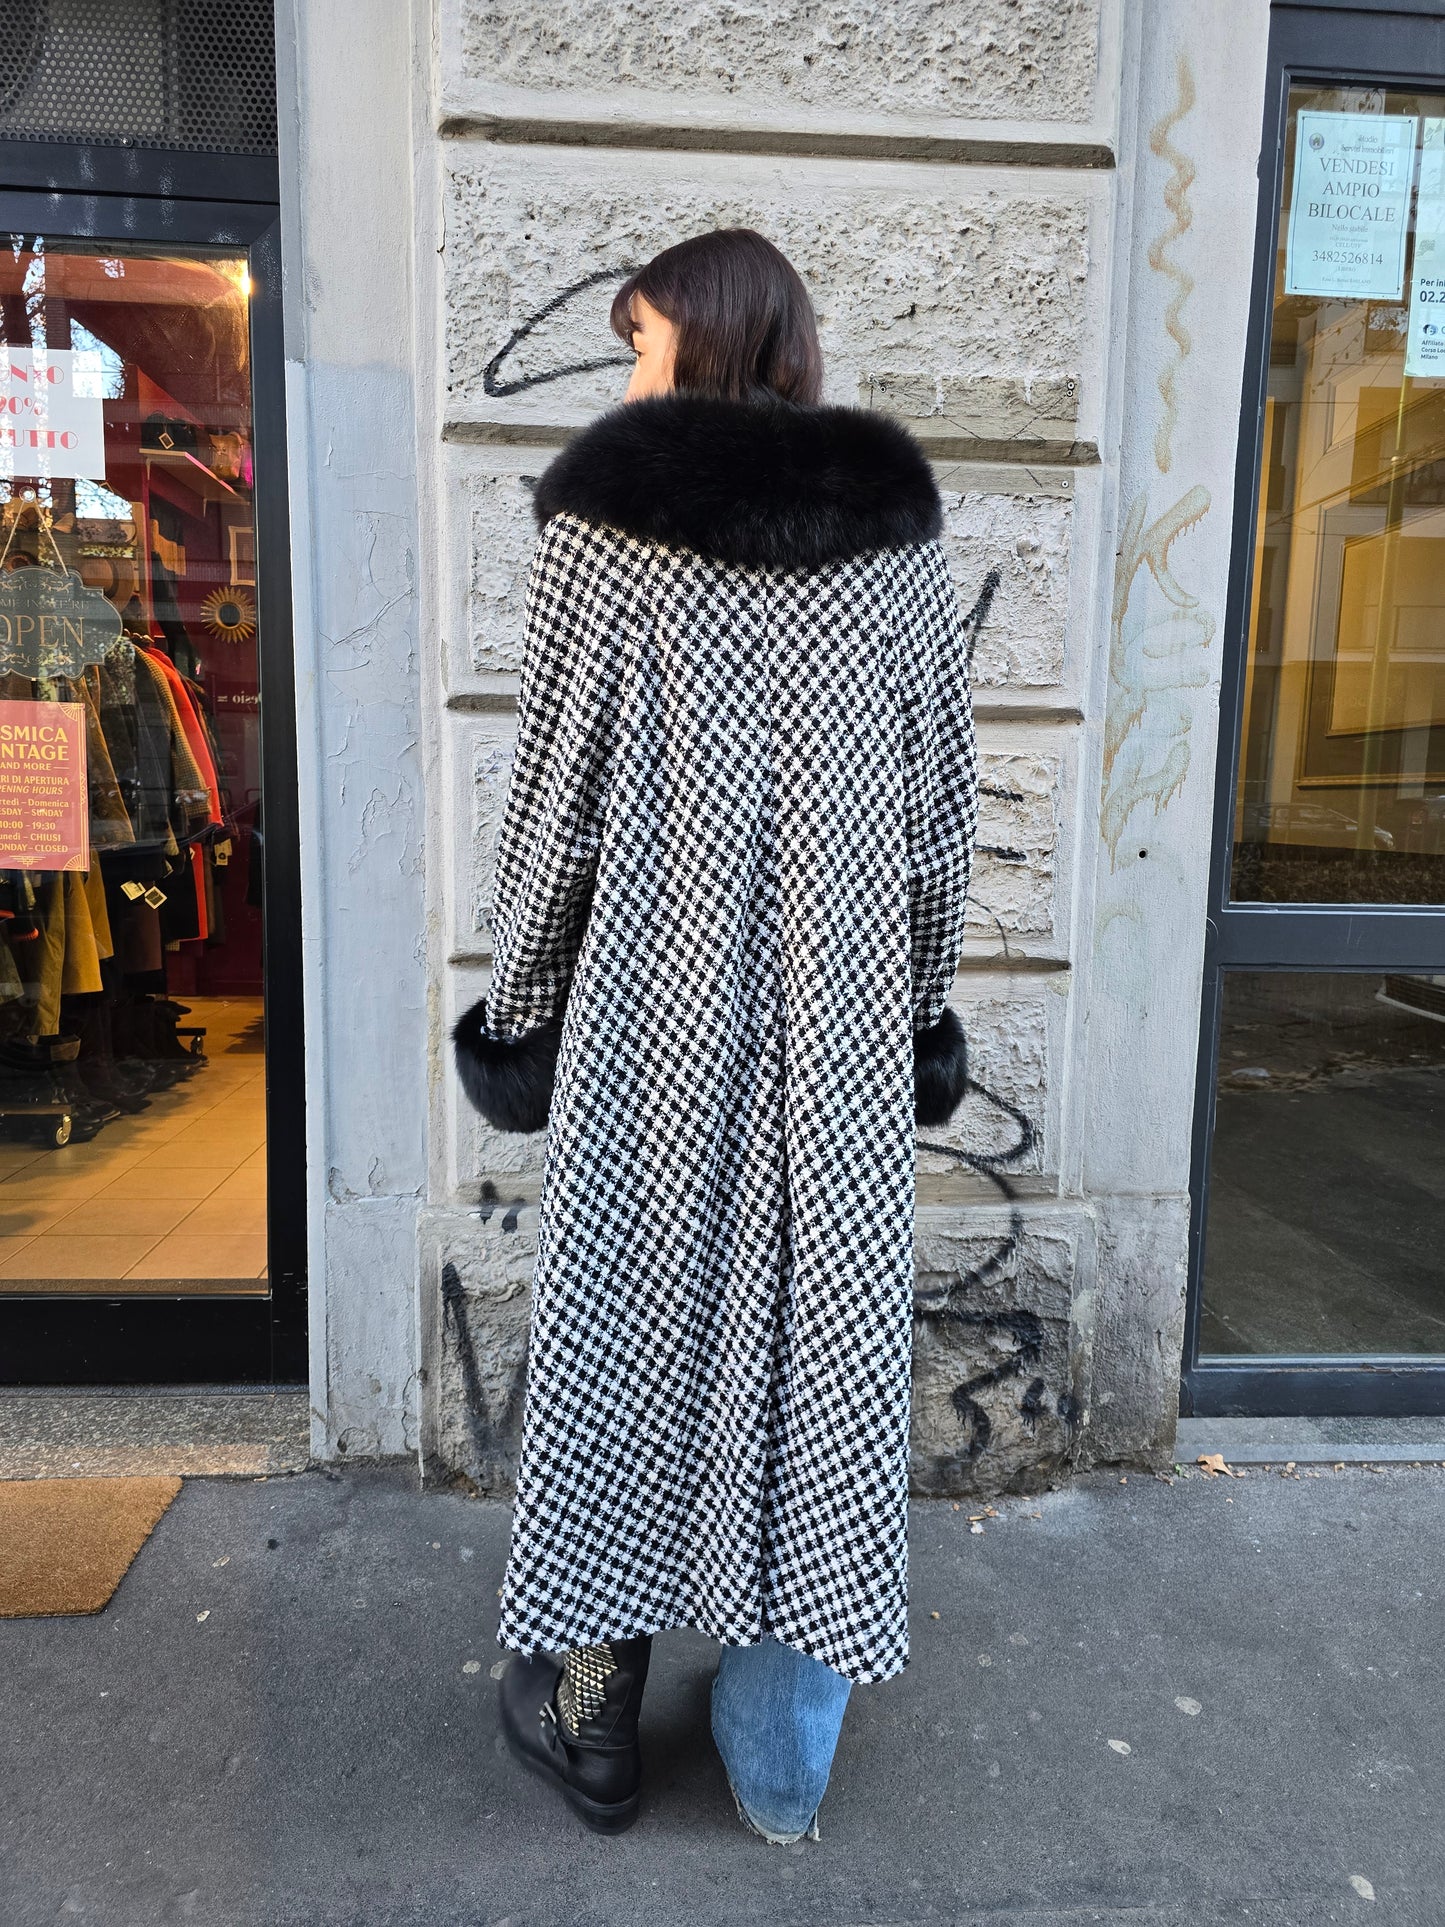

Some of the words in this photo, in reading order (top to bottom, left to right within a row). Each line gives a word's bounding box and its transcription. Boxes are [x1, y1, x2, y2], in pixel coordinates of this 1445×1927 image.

[1319, 157, 1395, 177] VENDESI
[1322, 181, 1380, 199] AMPIO
[1308, 203, 1396, 222] BILOCALE
[1312, 250, 1383, 264] 3482526814
[1420, 278, 1434, 287] Per
[0, 724, 68, 743] SMICA
[1, 742, 70, 761] NTAGE
[0, 761, 20, 770] AND
[23, 762, 52, 771] MORE
[12, 775, 21, 784] DI
[24, 775, 70, 786] APERTURA
[32, 786, 63, 795] HOURS
[28, 798, 69, 808] Domenica
[31, 808, 64, 818] SUNDAY
[32, 821, 56, 831] 19:30
[30, 833, 61, 842] CHIUSI
[34, 844, 69, 853] CLOSED
